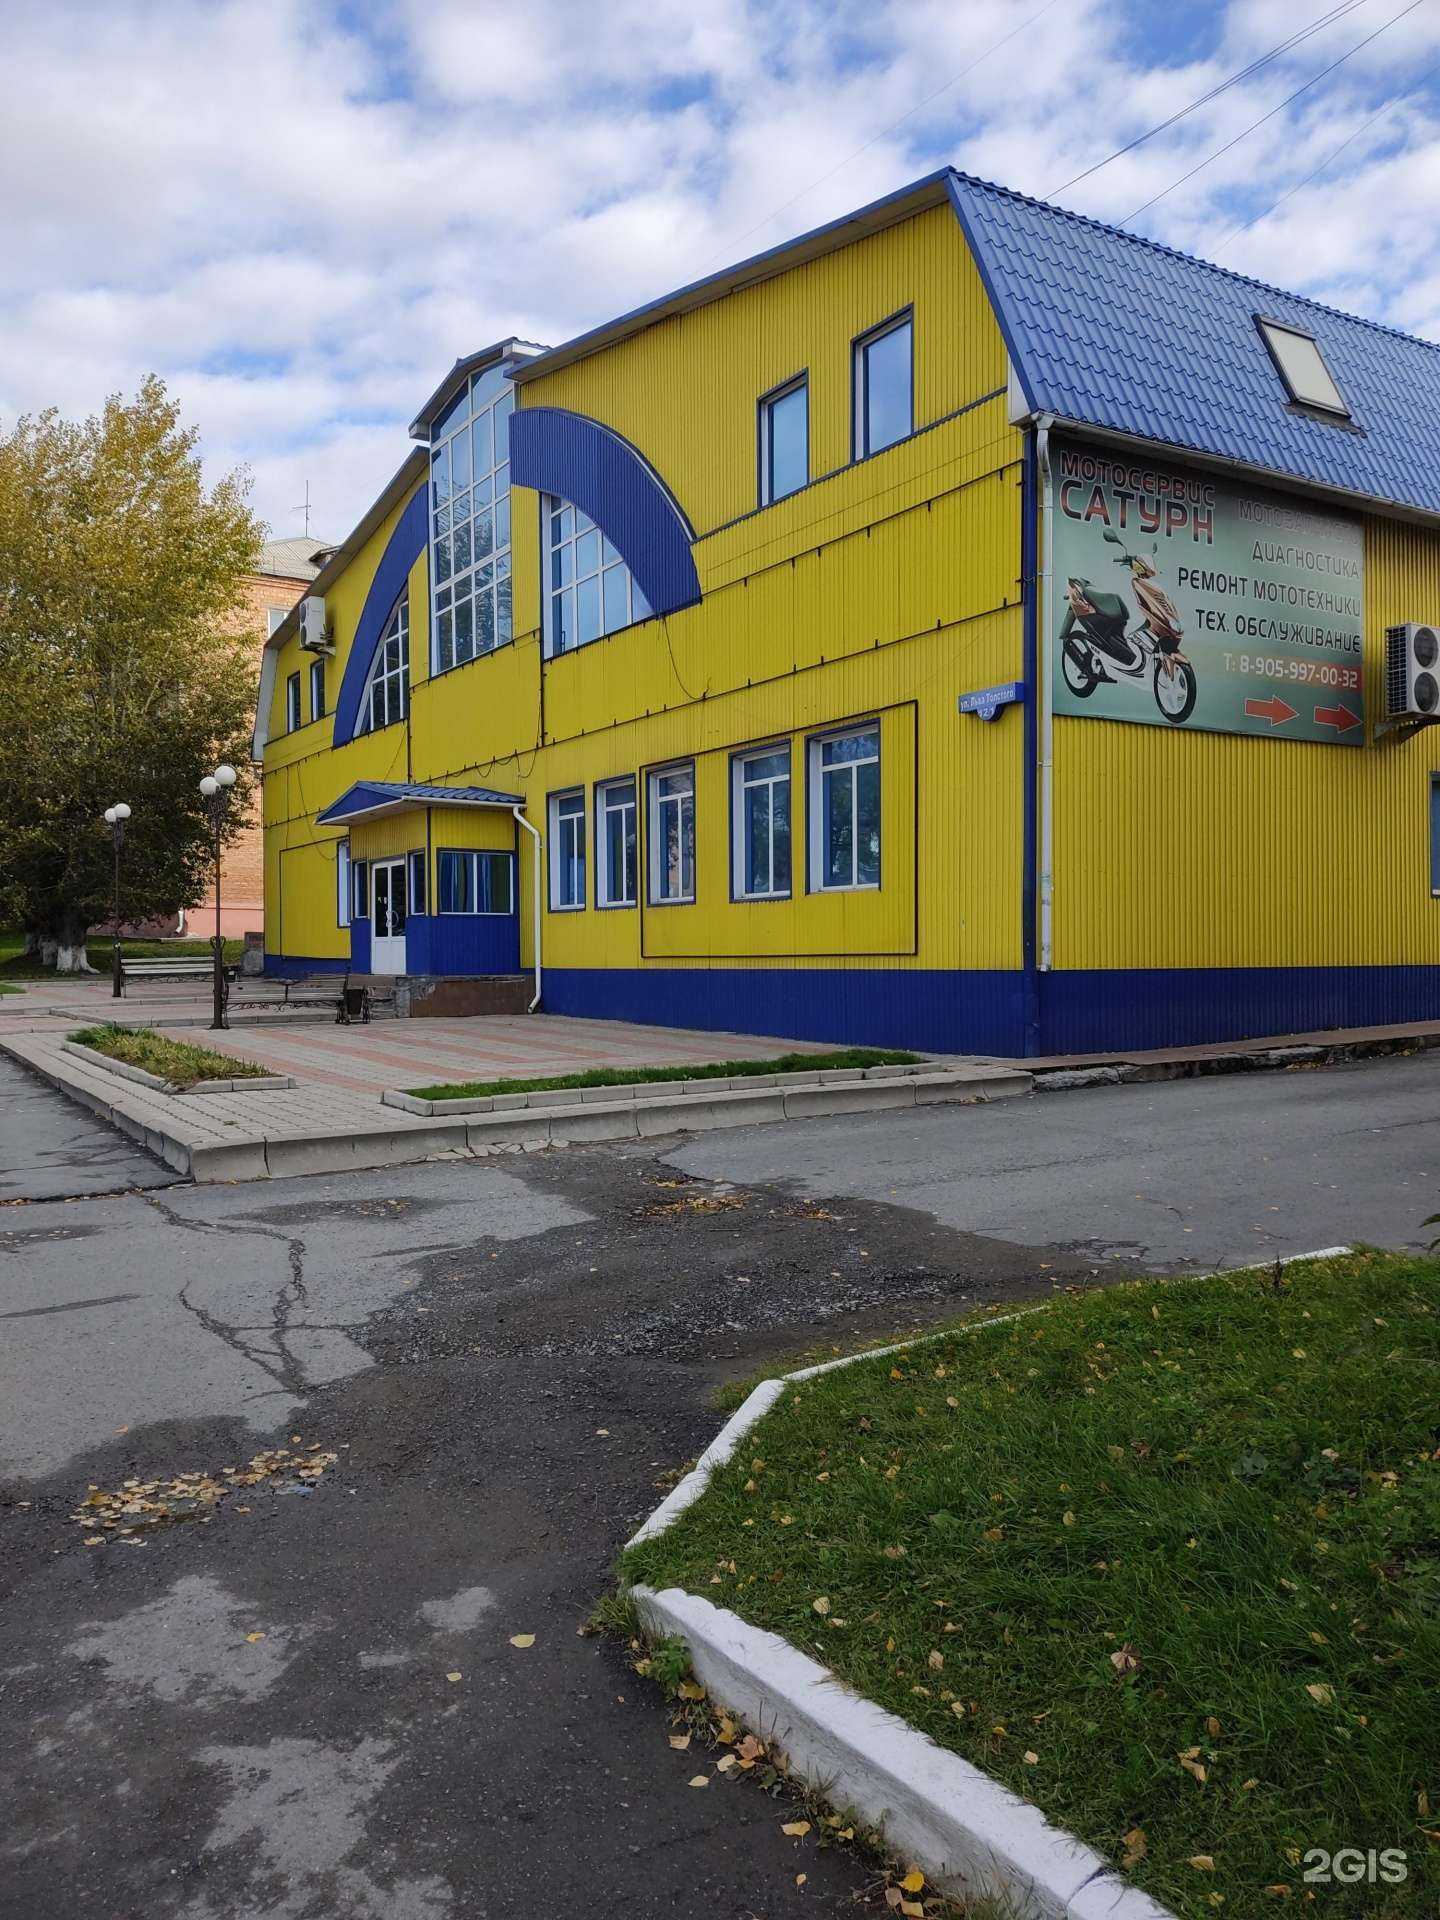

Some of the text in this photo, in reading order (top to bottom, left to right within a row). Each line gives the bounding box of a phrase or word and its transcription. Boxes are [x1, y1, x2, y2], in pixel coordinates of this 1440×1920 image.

[1060, 451, 1215, 507] МОТОСЕРВИС
[1060, 479, 1214, 545] САТУРН
[1253, 541, 1359, 578] ДИАГНОСТИКА
[1178, 567, 1361, 617] РЕМОНТ МОТОТЕХНИКИ
[1195, 609, 1361, 653] ТЕХ. ОБСЛУЖИВАНИЕ
[1239, 654, 1358, 688] 8-905-997-00-32
